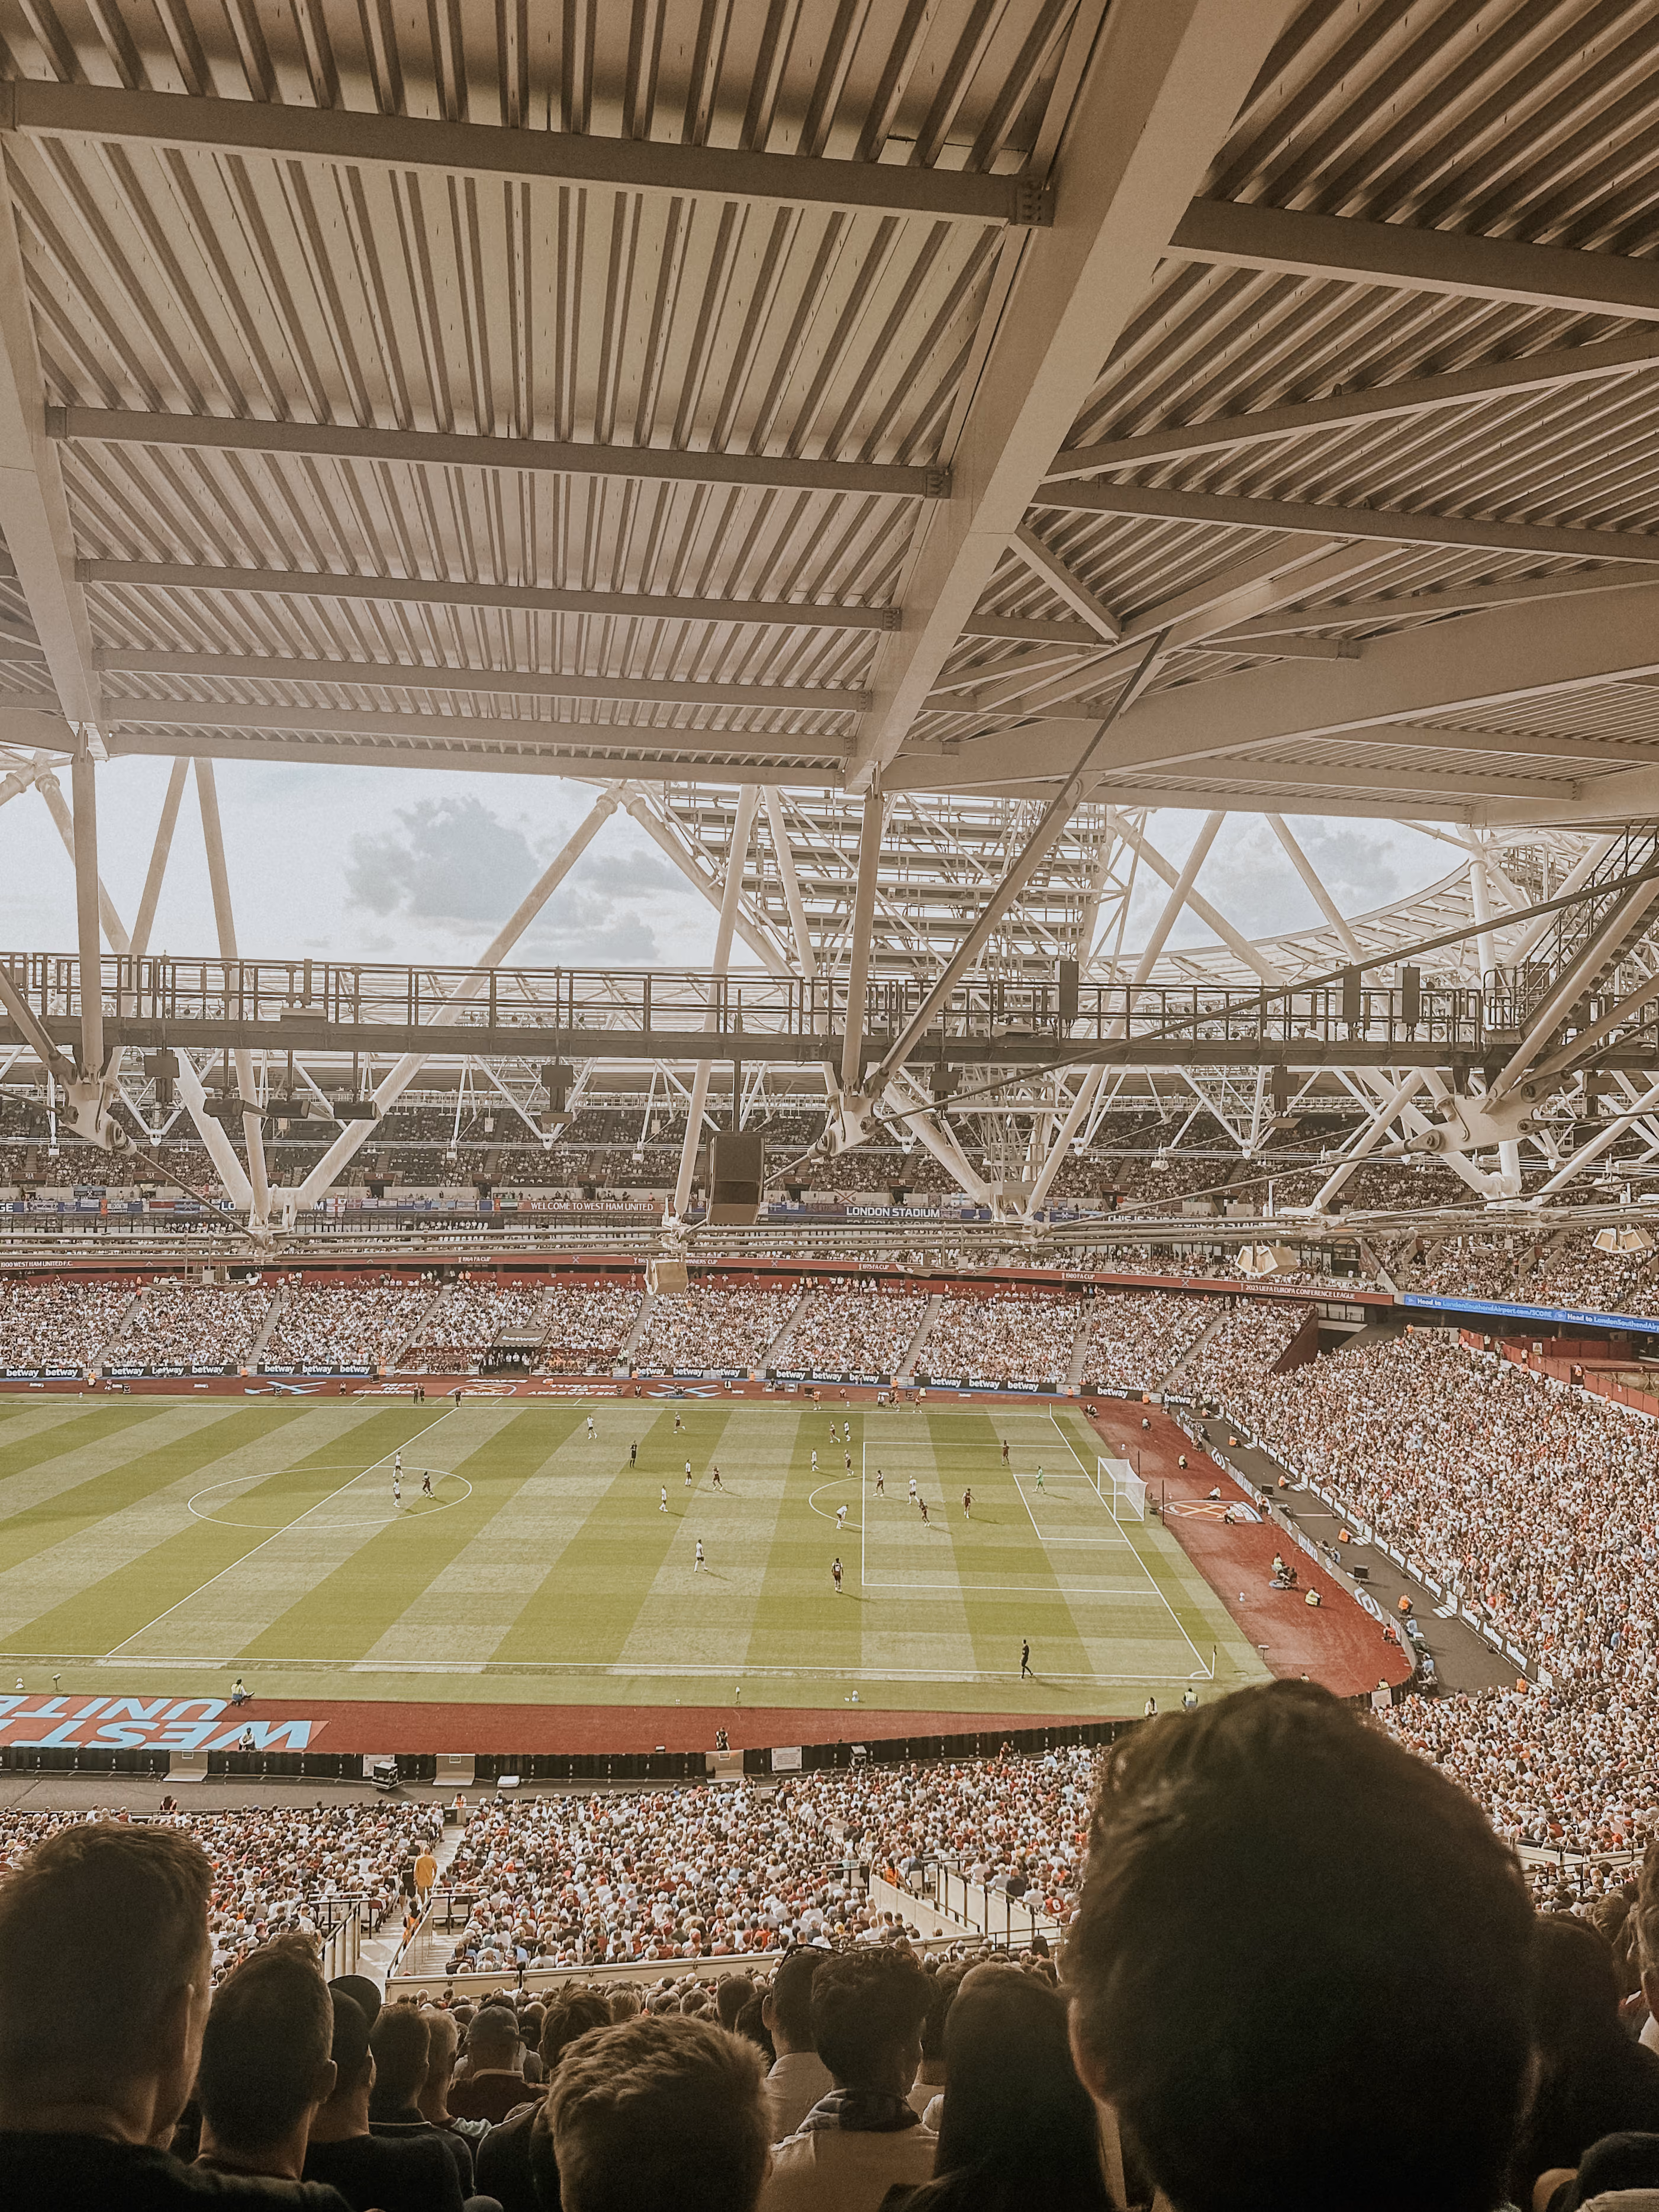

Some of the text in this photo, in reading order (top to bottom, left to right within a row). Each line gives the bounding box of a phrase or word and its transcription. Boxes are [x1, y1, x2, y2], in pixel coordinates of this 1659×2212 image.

[531, 1202, 654, 1211] WELCOME TO WEST HAM UNITED
[846, 1207, 890, 1216] LONDON
[892, 1208, 940, 1218] STADIUM
[1274, 1286, 1295, 1295] EUROPA
[1296, 1288, 1332, 1298] CONFERENCE
[1442, 1302, 1553, 1318] LondonSouthendAirport.com/SCORE
[1567, 1313, 1584, 1321] Head
[6, 1368, 39, 1378] betway
[45, 1368, 78, 1378] betway
[111, 1366, 144, 1376] betway
[192, 1365, 224, 1374] betway
[264, 1365, 295, 1374] betway
[302, 1365, 333, 1374] betway
[339, 1365, 371, 1374] betway
[636, 1367, 666, 1376] betway
[673, 1367, 703, 1377] betway
[776, 1370, 806, 1380] betway
[812, 1371, 843, 1382] betway
[930, 1376, 962, 1388] betway
[968, 1378, 1000, 1390] betway
[1007, 1381, 1039, 1392] betway
[1097, 1386, 1129, 1399] betway
[1164, 1394, 1191, 1404] betwa
[1298, 1533, 1318, 1562] umbro
[9, 1720, 312, 1750] WEST
